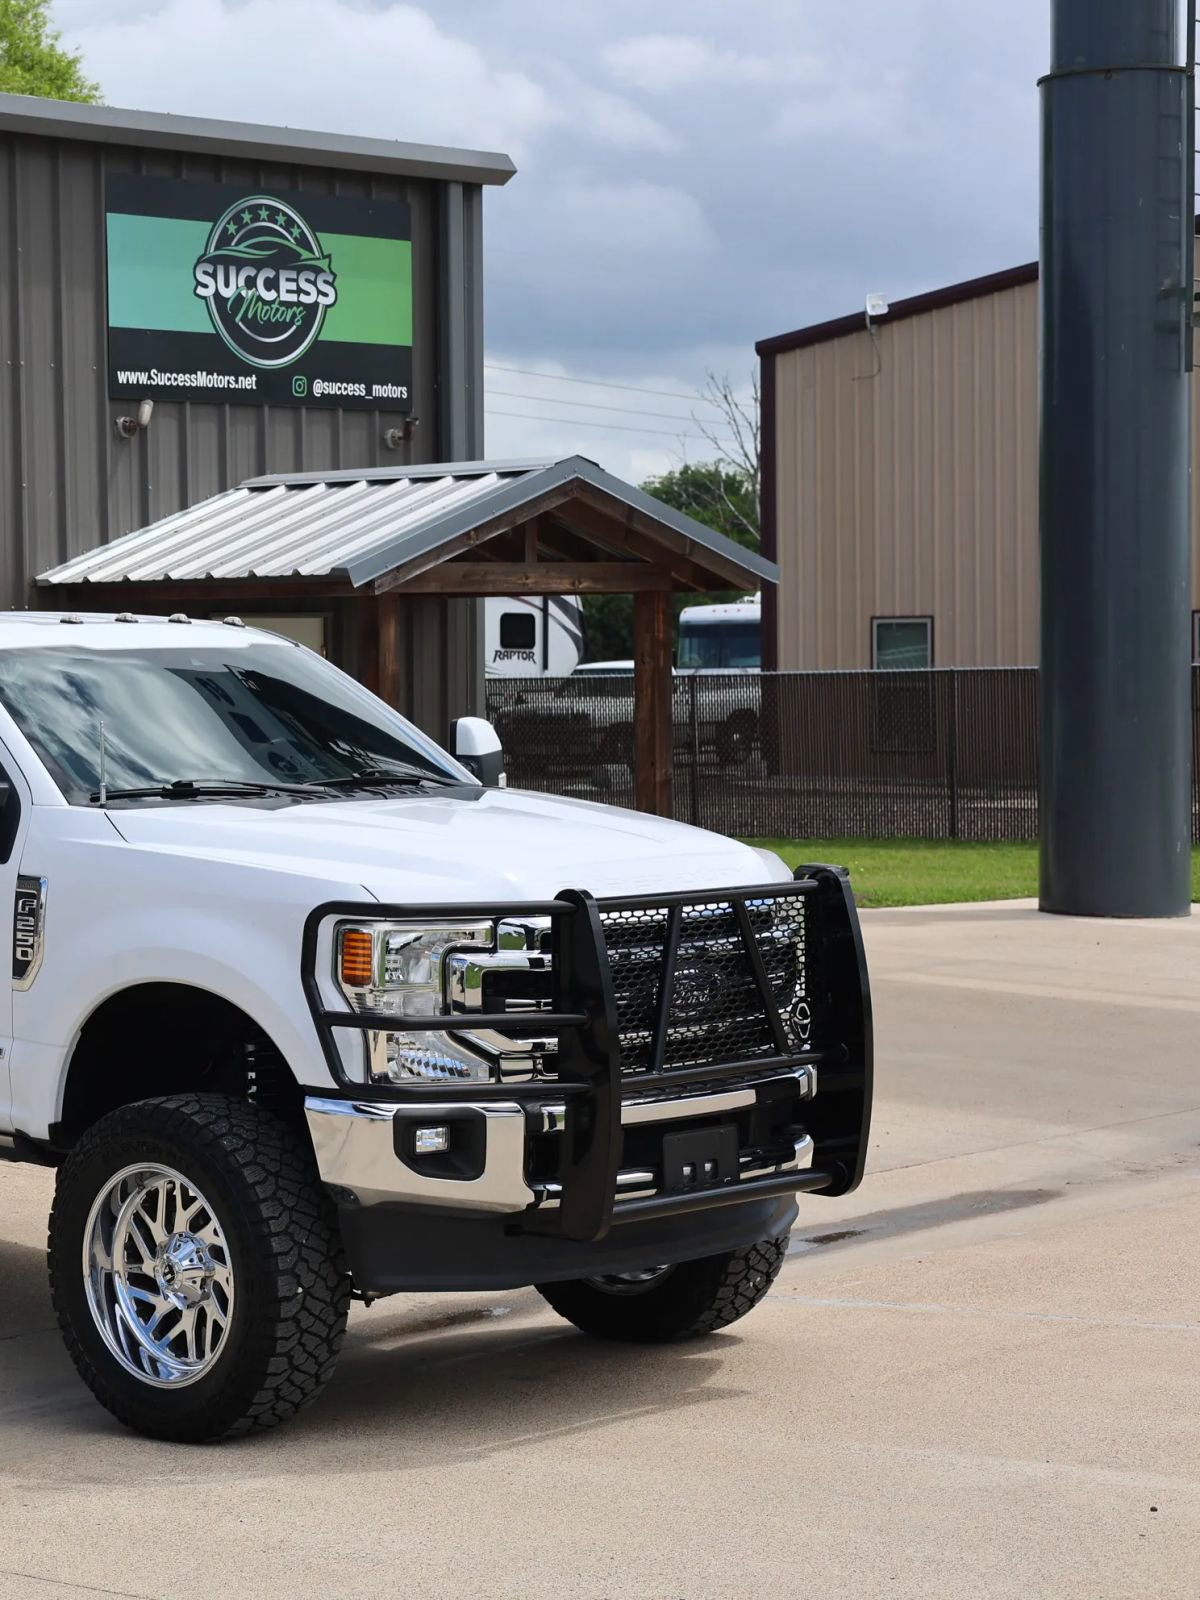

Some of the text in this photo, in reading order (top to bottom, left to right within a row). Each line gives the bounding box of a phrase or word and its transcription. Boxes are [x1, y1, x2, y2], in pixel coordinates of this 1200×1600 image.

[195, 262, 336, 305] SUCCESS
[227, 285, 307, 326] Motors
[117, 368, 257, 390] www.SuccessMotors.net
[313, 378, 408, 399] @success_motors
[492, 649, 537, 664] RAPTOR
